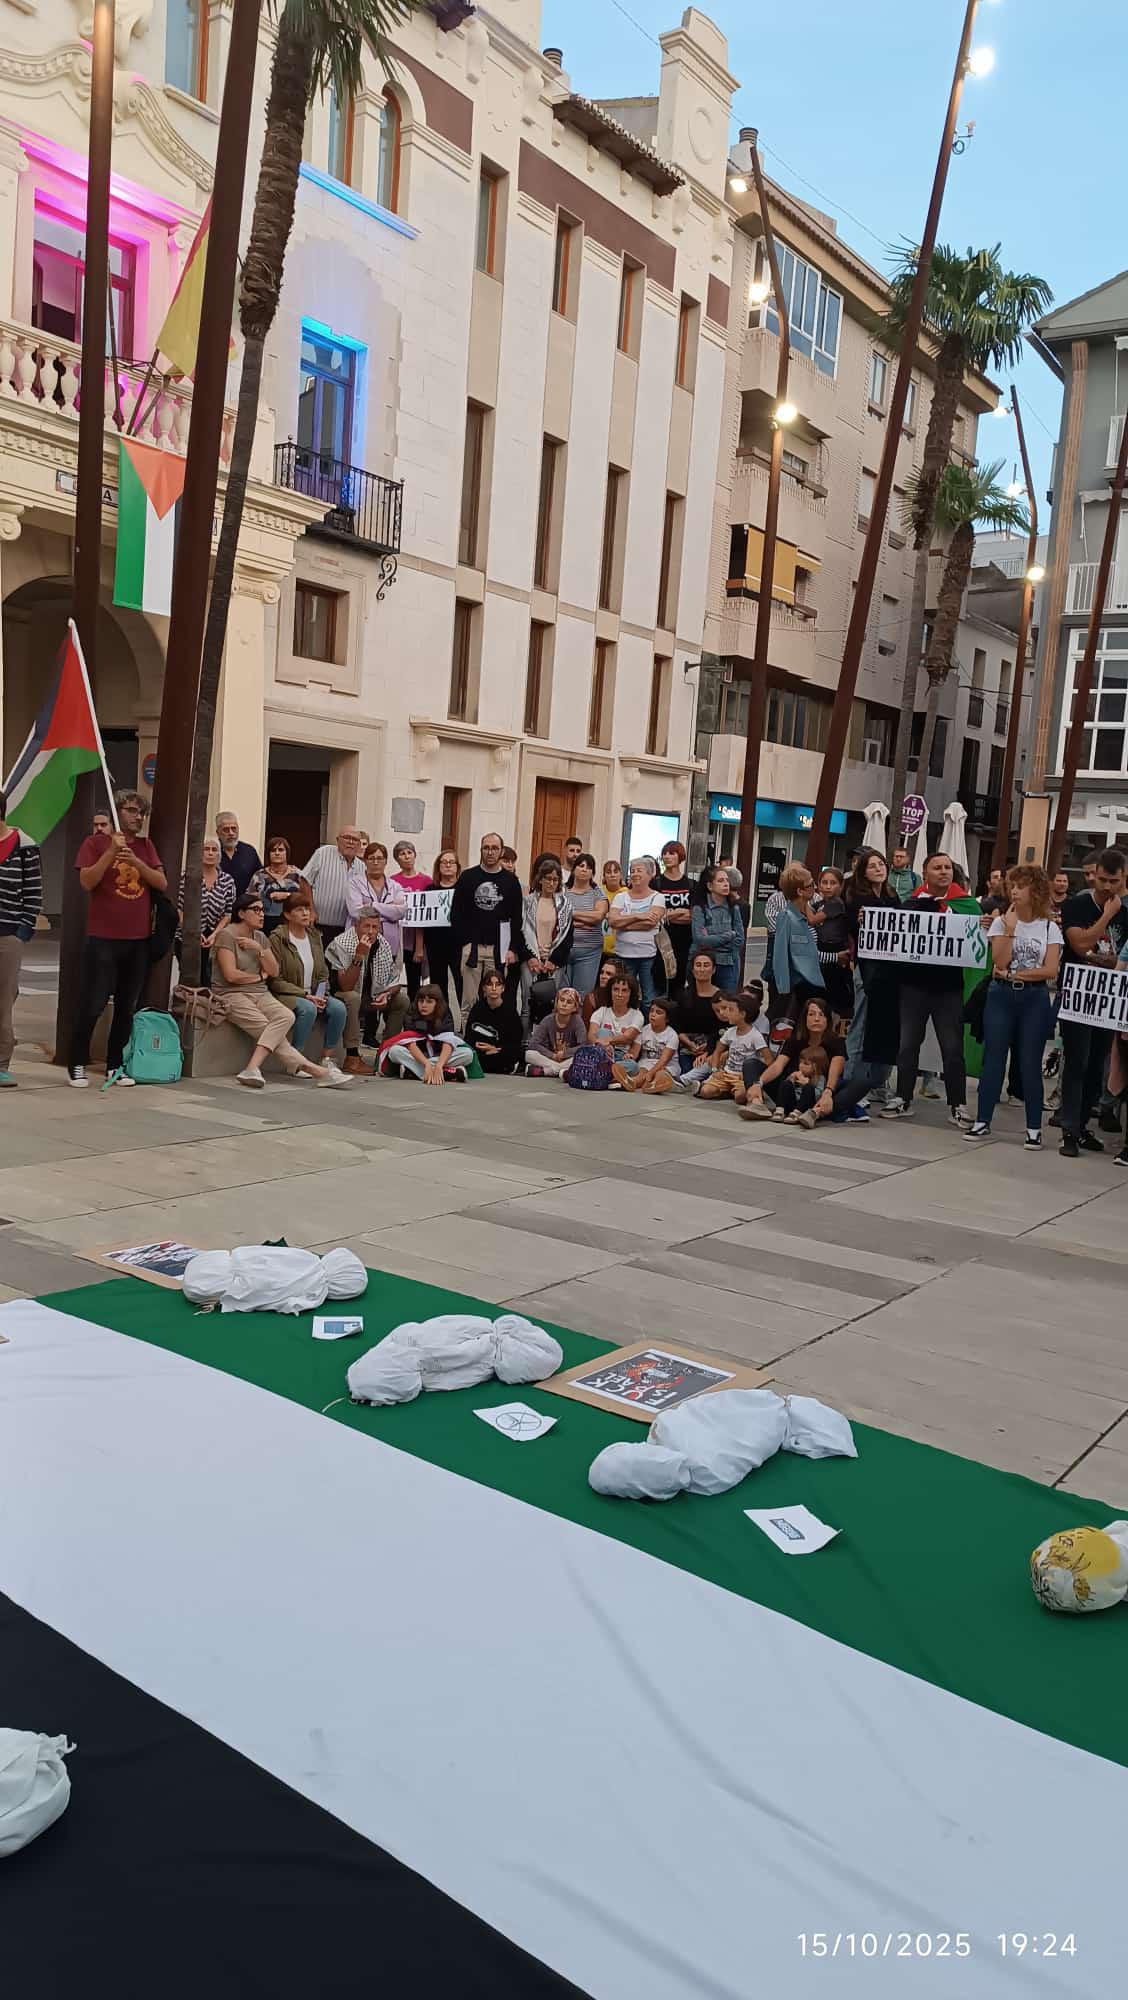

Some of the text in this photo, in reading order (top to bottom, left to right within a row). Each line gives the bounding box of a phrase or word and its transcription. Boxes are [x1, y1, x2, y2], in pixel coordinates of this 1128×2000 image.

[413, 893, 426, 907] LA
[664, 893, 690, 906] FCK
[928, 915, 947, 936] LA
[858, 930, 965, 959] COMPLICITAT
[1062, 989, 1128, 1022] COMPLI
[588, 1377, 666, 1406] FUCK
[604, 1371, 678, 1399] ISRAEL
